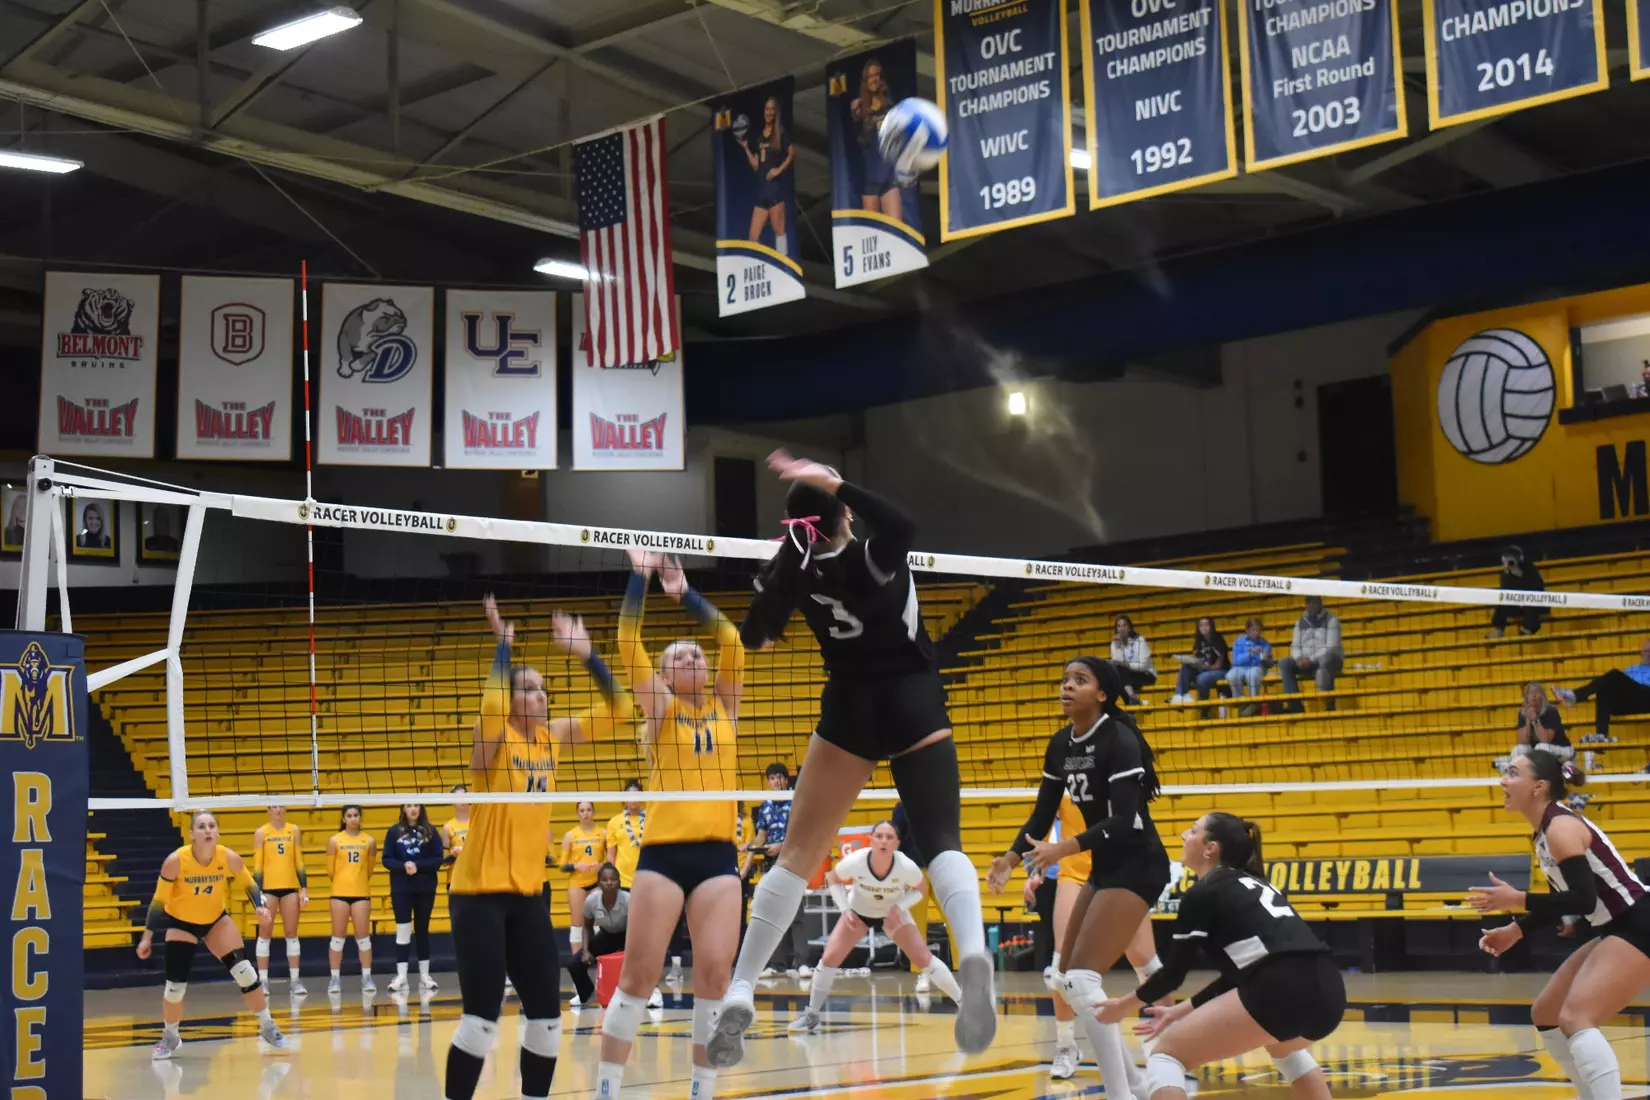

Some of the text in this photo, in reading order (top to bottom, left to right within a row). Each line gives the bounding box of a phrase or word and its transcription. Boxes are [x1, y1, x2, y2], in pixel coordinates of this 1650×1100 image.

[971, 4, 1028, 27] VOLLEYBALL
[1096, 7, 1212, 55] TOURNAMENT
[981, 28, 1023, 59] OVC
[1106, 36, 1207, 79] CHAMPIONS
[1291, 35, 1351, 69] NCAA
[949, 52, 1056, 94] TOURNAMENT
[1273, 57, 1375, 98] First Round
[1476, 48, 1554, 92] 2014
[958, 80, 1050, 117] CHAMPIONS
[1135, 90, 1183, 121] NIVC
[1292, 96, 1361, 138] 2003
[980, 130, 1029, 159] WIVC
[1130, 138, 1193, 175] 1992
[979, 176, 1036, 210] 1989
[862, 235, 877, 255] LILY
[843, 245, 854, 277] 5
[862, 251, 891, 273] EVANS
[727, 273, 736, 304] 2
[744, 280, 772, 301] BROCK
[60, 333, 142, 358] BELMONT
[223, 314, 253, 353] B
[363, 334, 417, 383] D
[57, 395, 139, 438] VALLEY
[84, 398, 110, 408] THE
[221, 401, 247, 411] THE
[362, 408, 387, 418] THE
[488, 412, 512, 421] THE
[615, 414, 639, 422] THE
[195, 398, 275, 440] VALLEY
[335, 405, 416, 446] VALLEY
[462, 409, 540, 449] VALLEY
[589, 412, 667, 450] VALLEY
[313, 506, 444, 530] RACER VOLLEYBALL
[593, 530, 704, 551] RACER VOLLEYBALL
[1035, 565, 1118, 580] RACER VOLLEYBALL
[1212, 576, 1284, 590] RACER VOLLEYBALL
[1368, 585, 1432, 598] RACER VOLLEYBALL
[810, 593, 864, 639] 3
[1067, 773, 1094, 802] 22
[277, 843, 285, 855] 5
[347, 851, 360, 864] 12
[584, 844, 592, 856] 4
[193, 886, 214, 896] 14
[1238, 877, 1295, 918] 2
